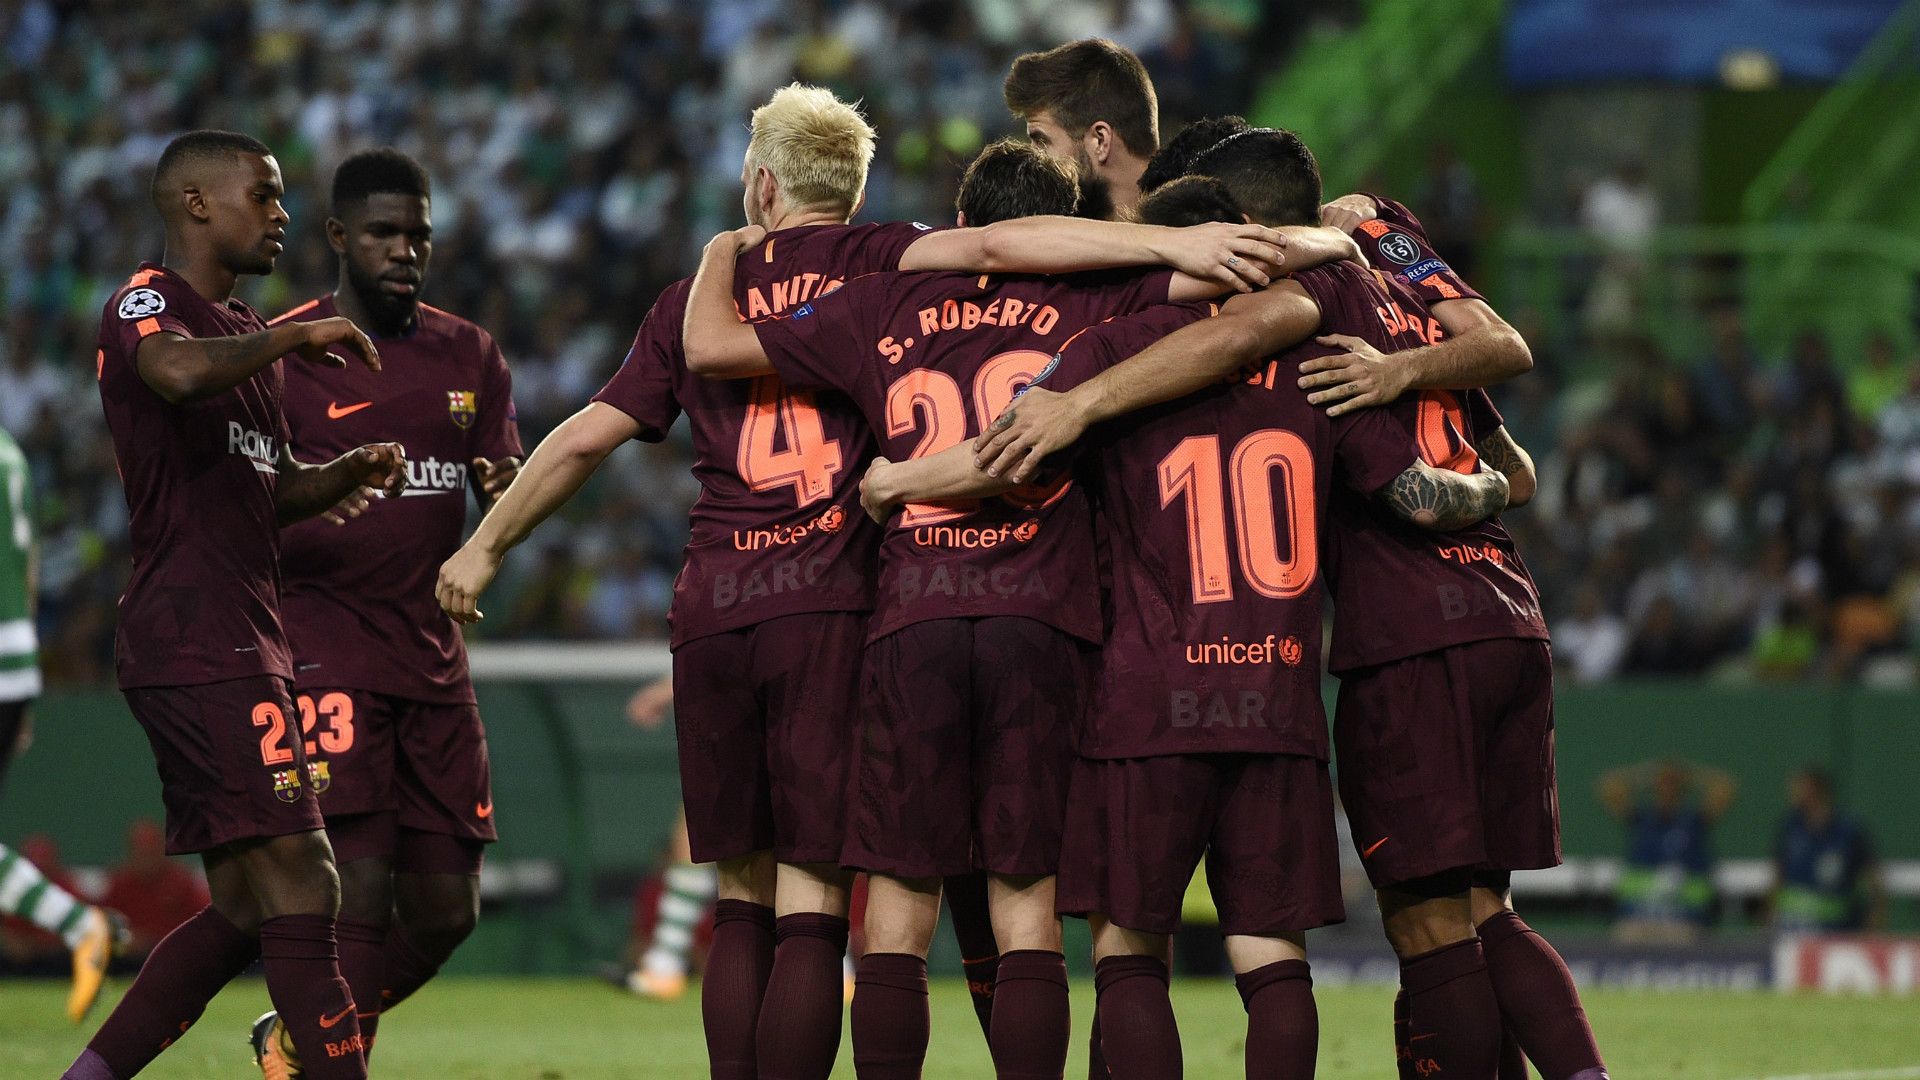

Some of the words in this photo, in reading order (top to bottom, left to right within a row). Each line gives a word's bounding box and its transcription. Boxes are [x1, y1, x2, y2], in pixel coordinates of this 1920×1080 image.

[1407, 260, 1446, 280] RESPEC
[877, 335, 915, 365] S.
[918, 297, 1060, 338] ROBERTO
[736, 374, 844, 509] 4
[914, 523, 1011, 550] unicef
[1157, 428, 1319, 605] 10
[1185, 634, 1276, 665] unicef
[251, 701, 294, 767] 2
